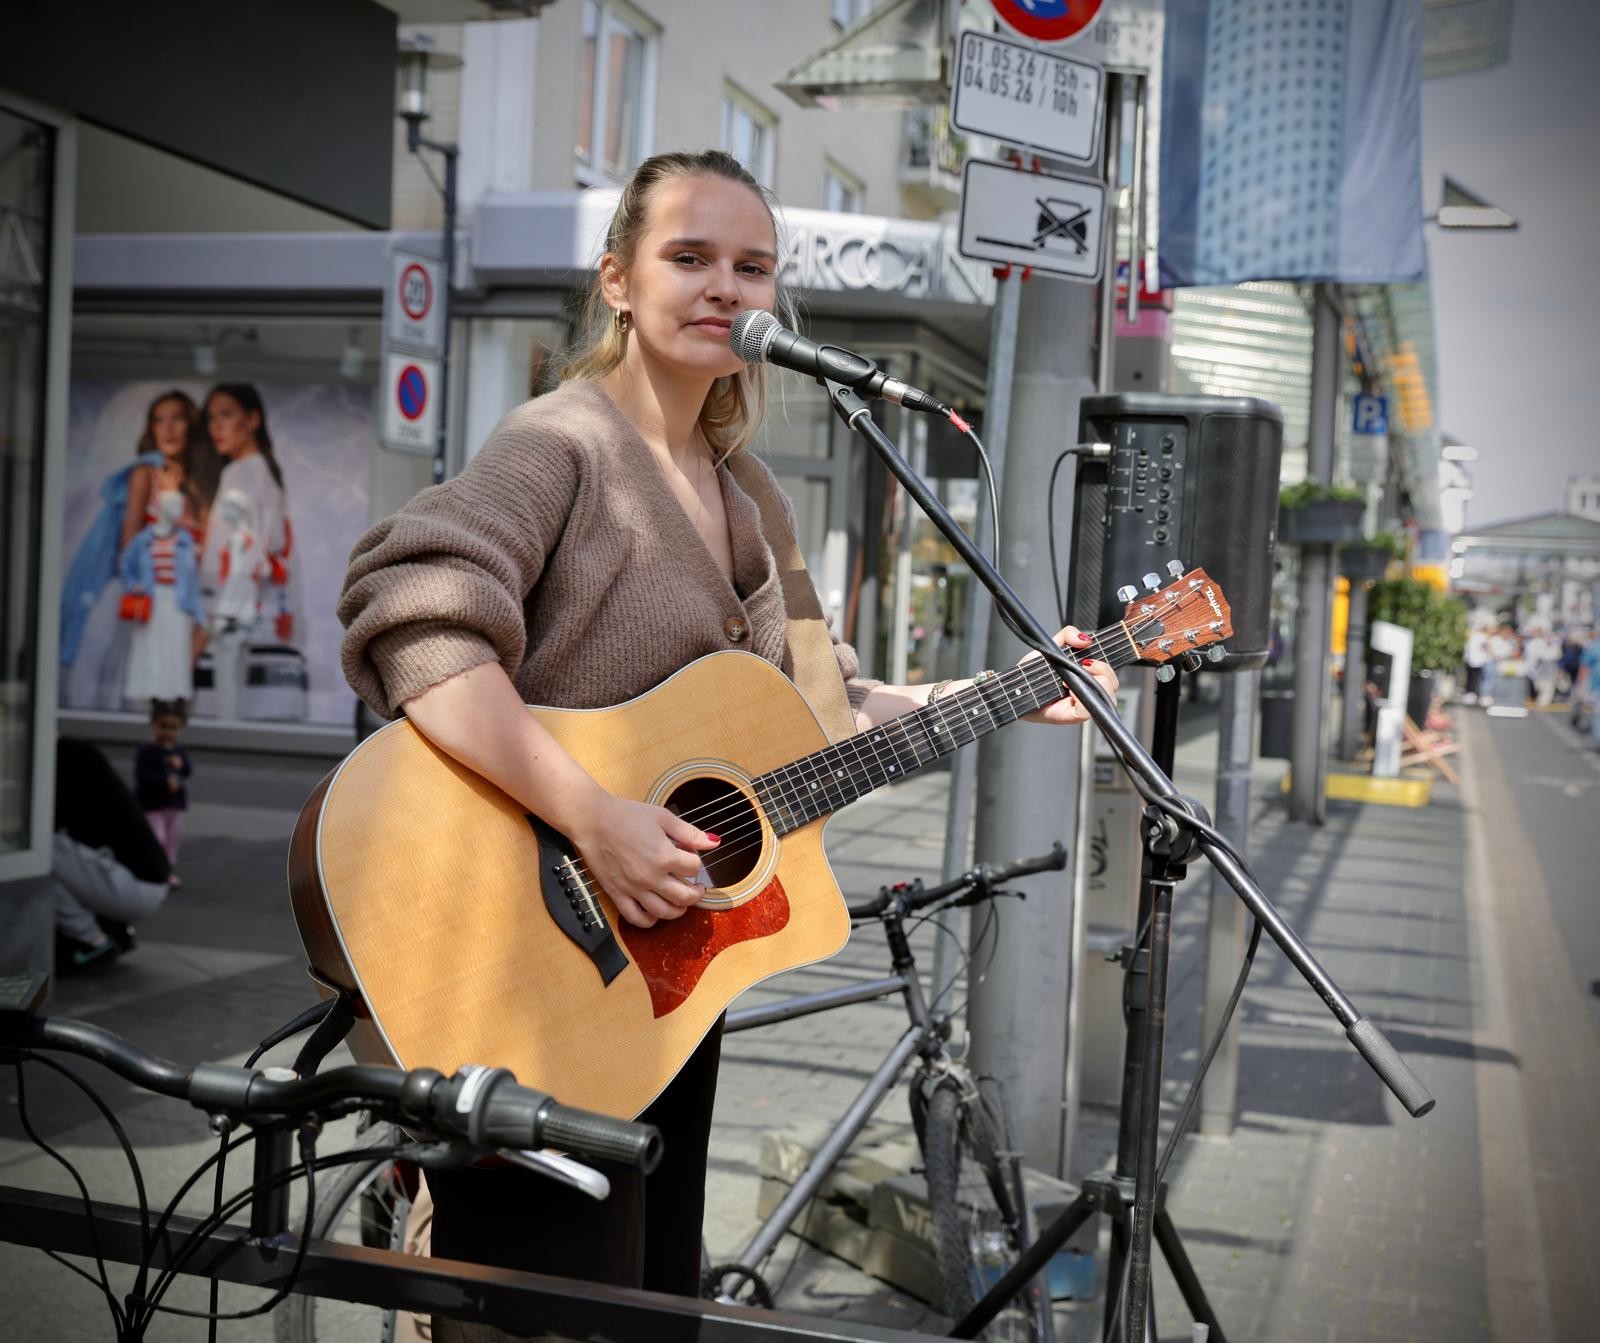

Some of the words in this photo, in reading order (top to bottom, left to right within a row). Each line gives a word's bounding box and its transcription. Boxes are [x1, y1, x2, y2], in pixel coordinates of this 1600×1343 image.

[966, 39, 1035, 77] 01.05.26
[1054, 63, 1079, 90] 15h
[963, 64, 1033, 104] 04.05.26
[1053, 89, 1078, 117] 10h
[1205, 585, 1223, 618] Taylor
